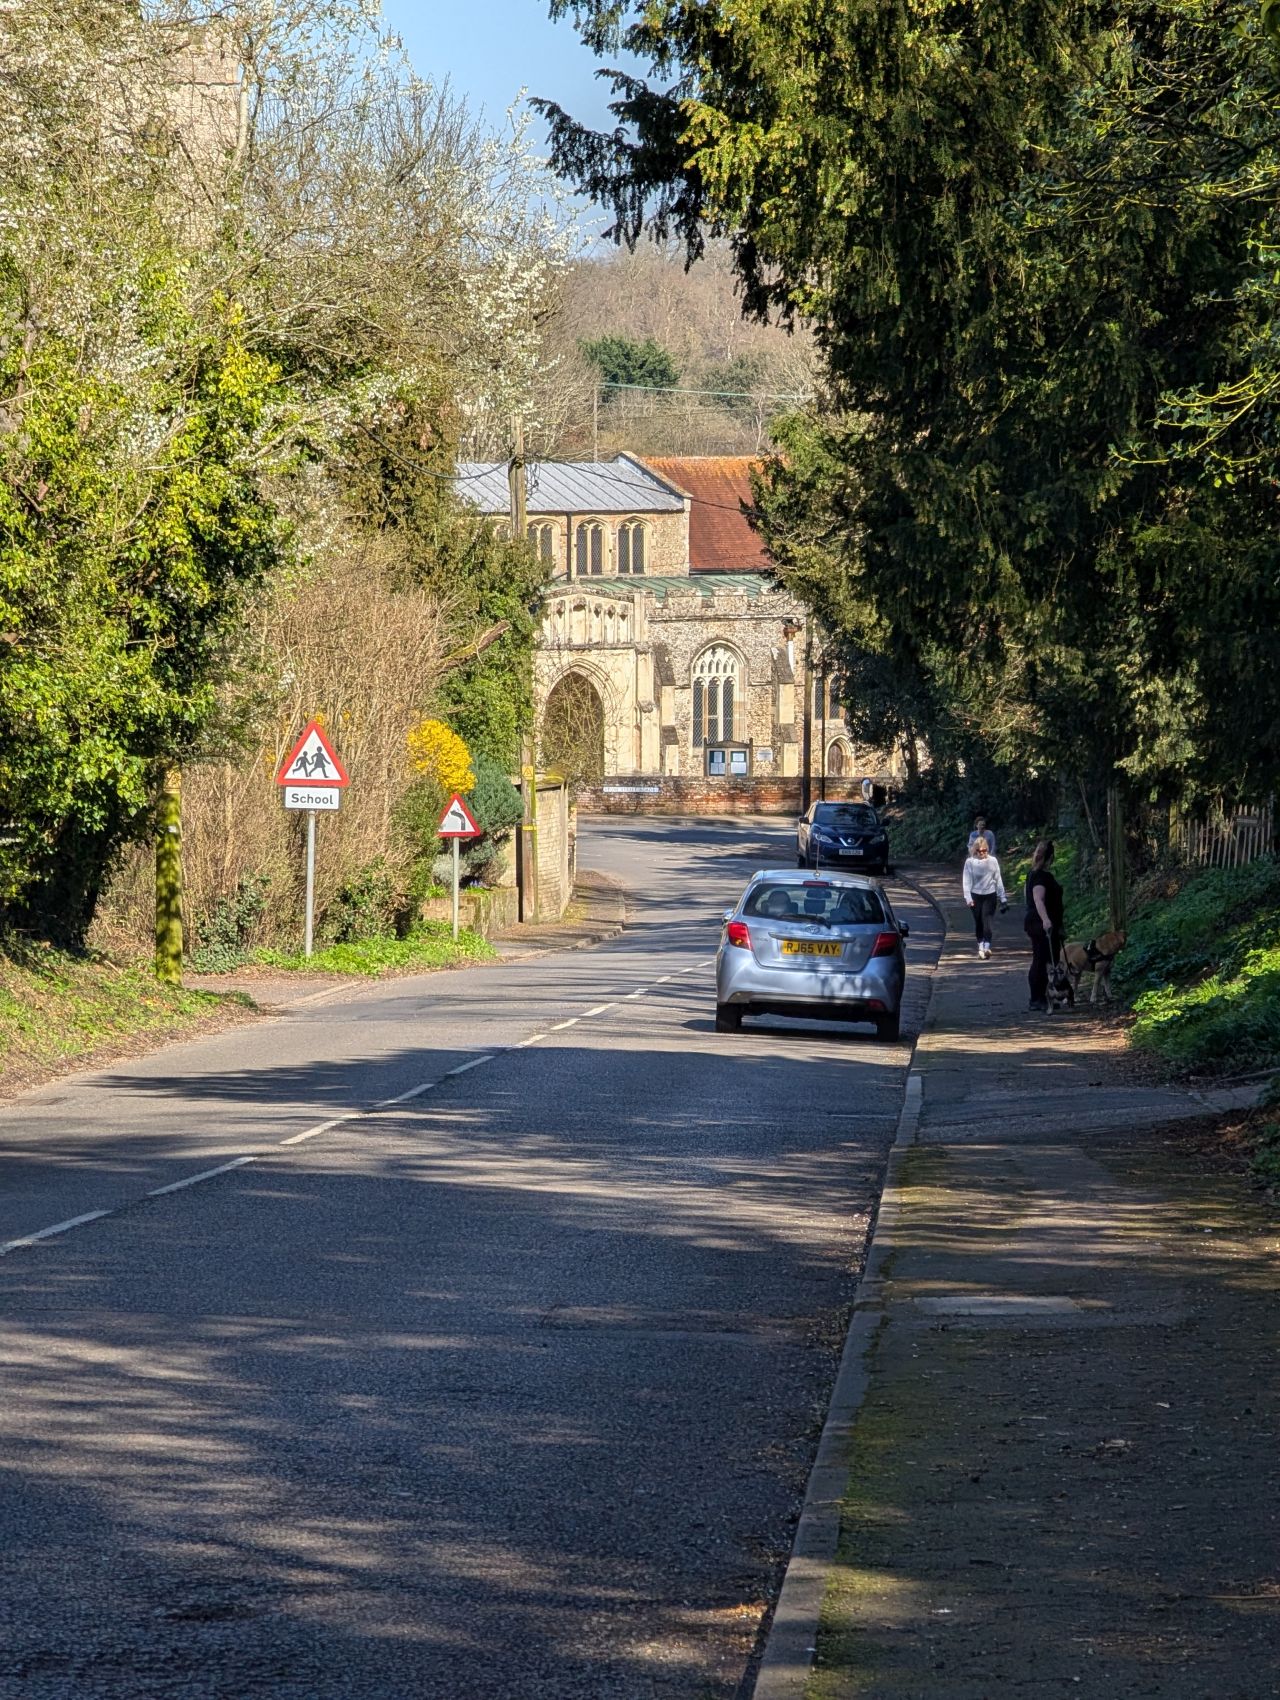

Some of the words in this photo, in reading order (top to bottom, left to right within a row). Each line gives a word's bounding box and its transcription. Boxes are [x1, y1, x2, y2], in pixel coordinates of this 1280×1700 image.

[291, 793, 334, 805] School
[786, 942, 814, 953] RJ65
[817, 943, 837, 954] VAY
